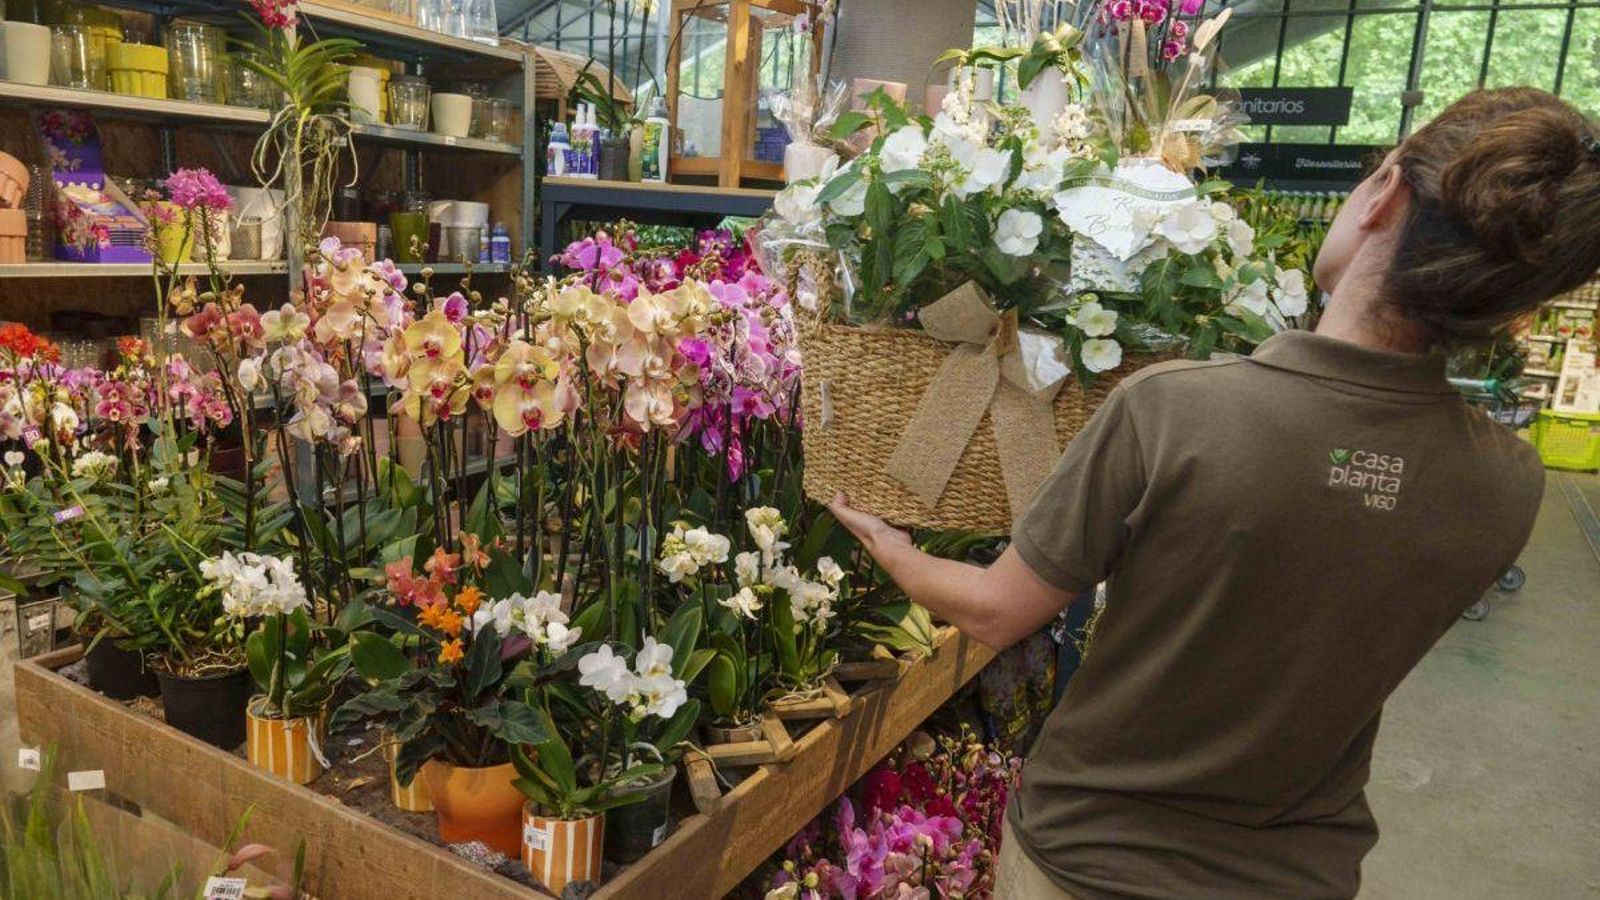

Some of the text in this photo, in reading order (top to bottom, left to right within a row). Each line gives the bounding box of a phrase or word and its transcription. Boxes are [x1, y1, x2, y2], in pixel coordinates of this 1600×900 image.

[1233, 97, 1304, 114] anitarios
[1351, 450, 1404, 475] casa
[1328, 465, 1400, 494] planta
